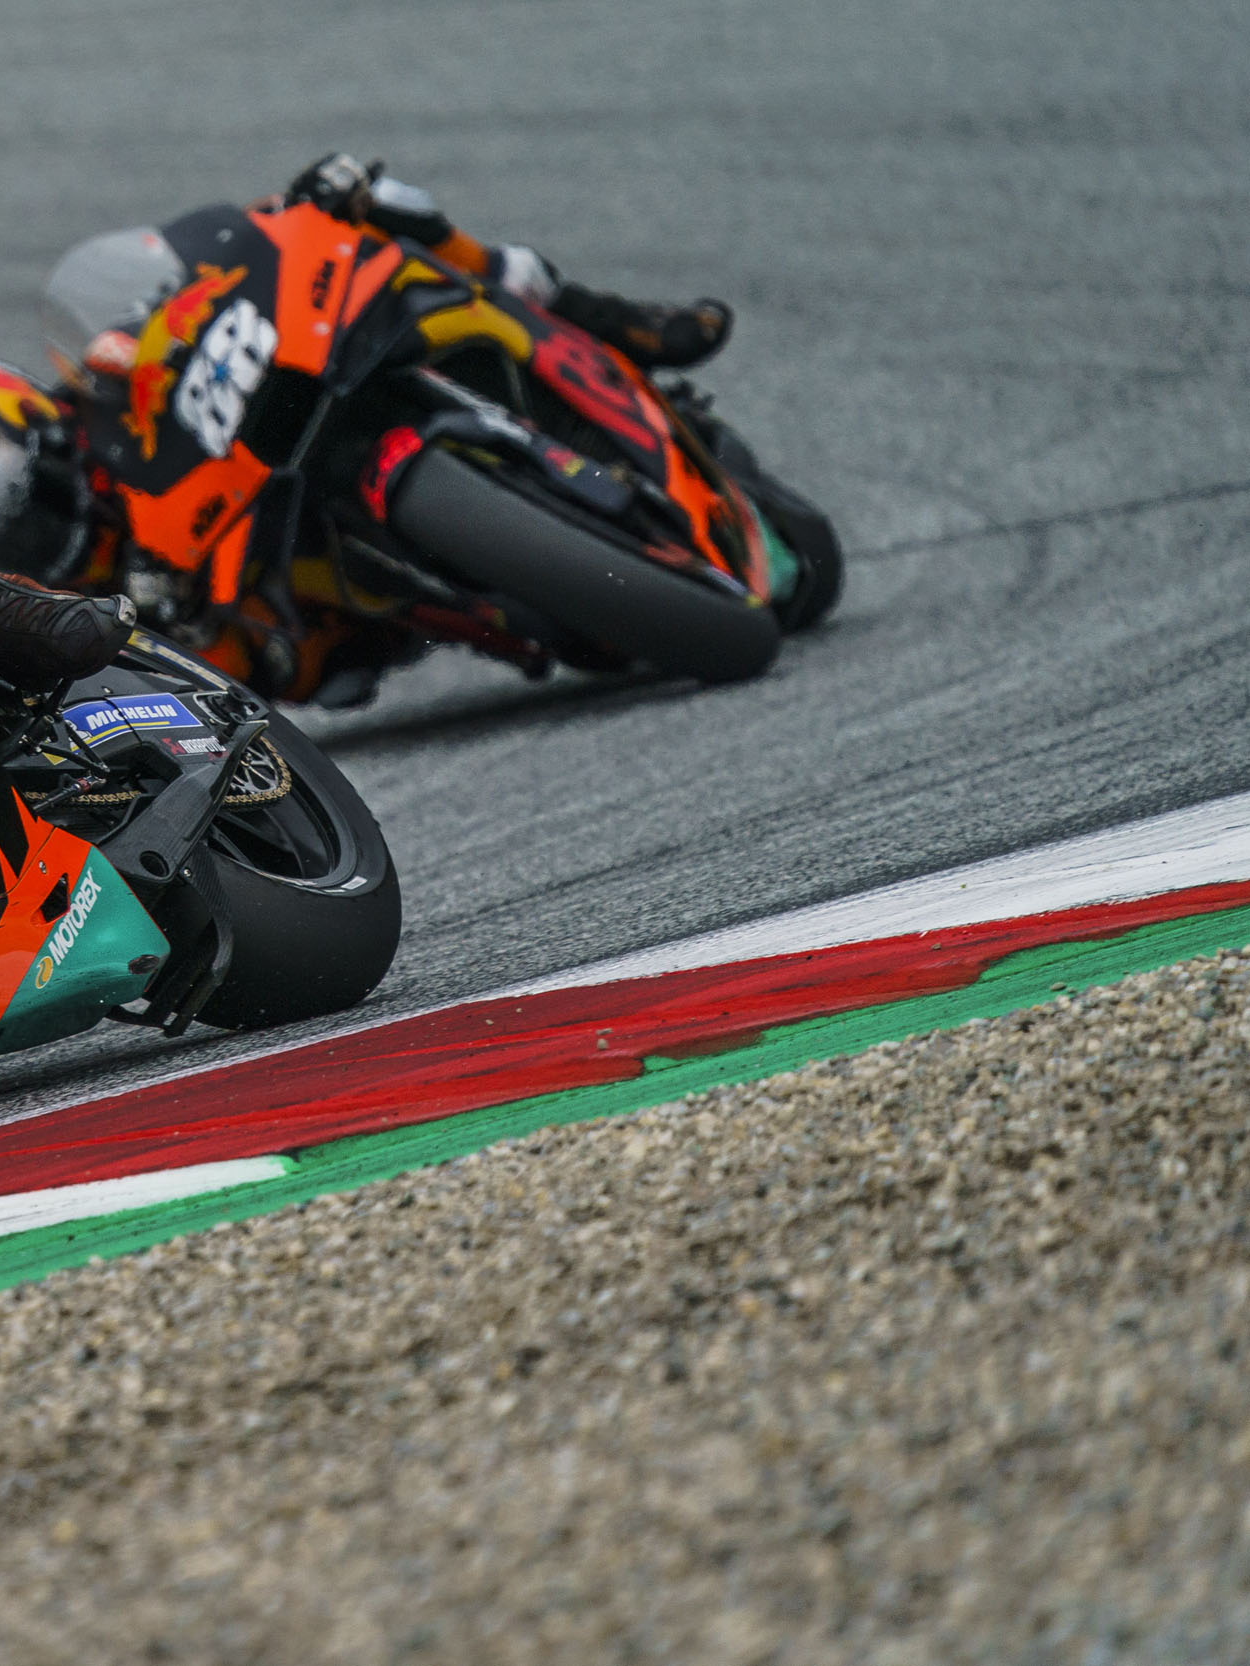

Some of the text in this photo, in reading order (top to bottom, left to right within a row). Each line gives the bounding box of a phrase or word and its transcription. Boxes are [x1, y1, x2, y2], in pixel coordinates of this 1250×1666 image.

[175, 297, 279, 458] 88
[85, 704, 178, 730] MICHELIN
[49, 868, 103, 966] MOTOREX
